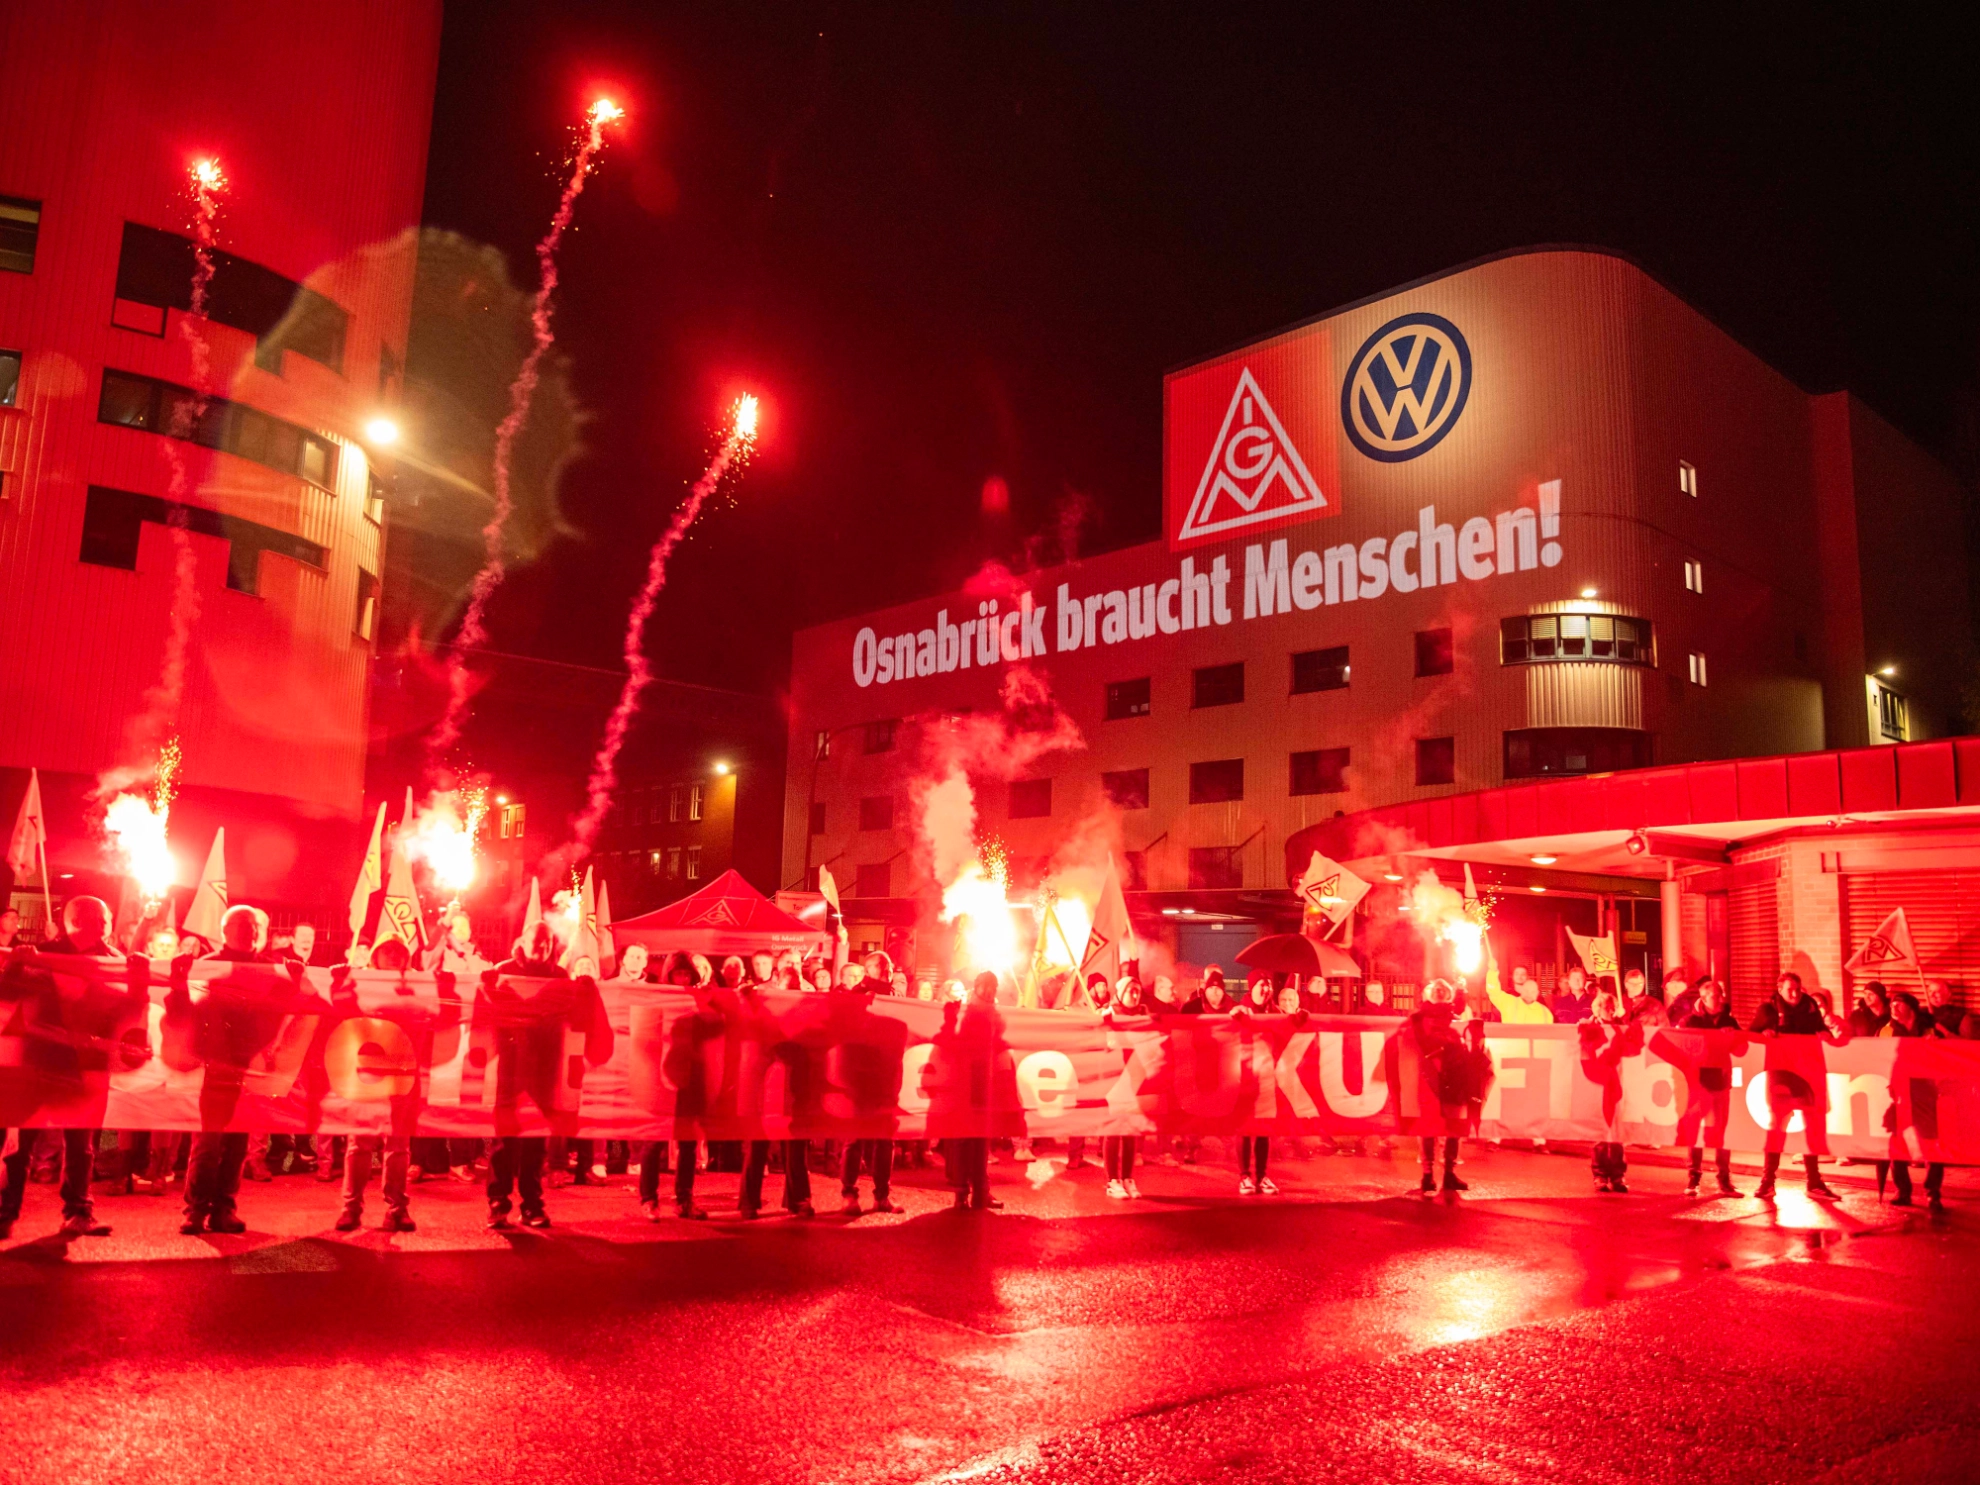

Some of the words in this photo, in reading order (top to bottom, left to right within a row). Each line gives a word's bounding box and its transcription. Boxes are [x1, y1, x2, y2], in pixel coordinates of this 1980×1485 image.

[852, 591, 1047, 688] Osnabrück
[1057, 554, 1232, 653] braucht
[1243, 478, 1563, 620] Menschen!
